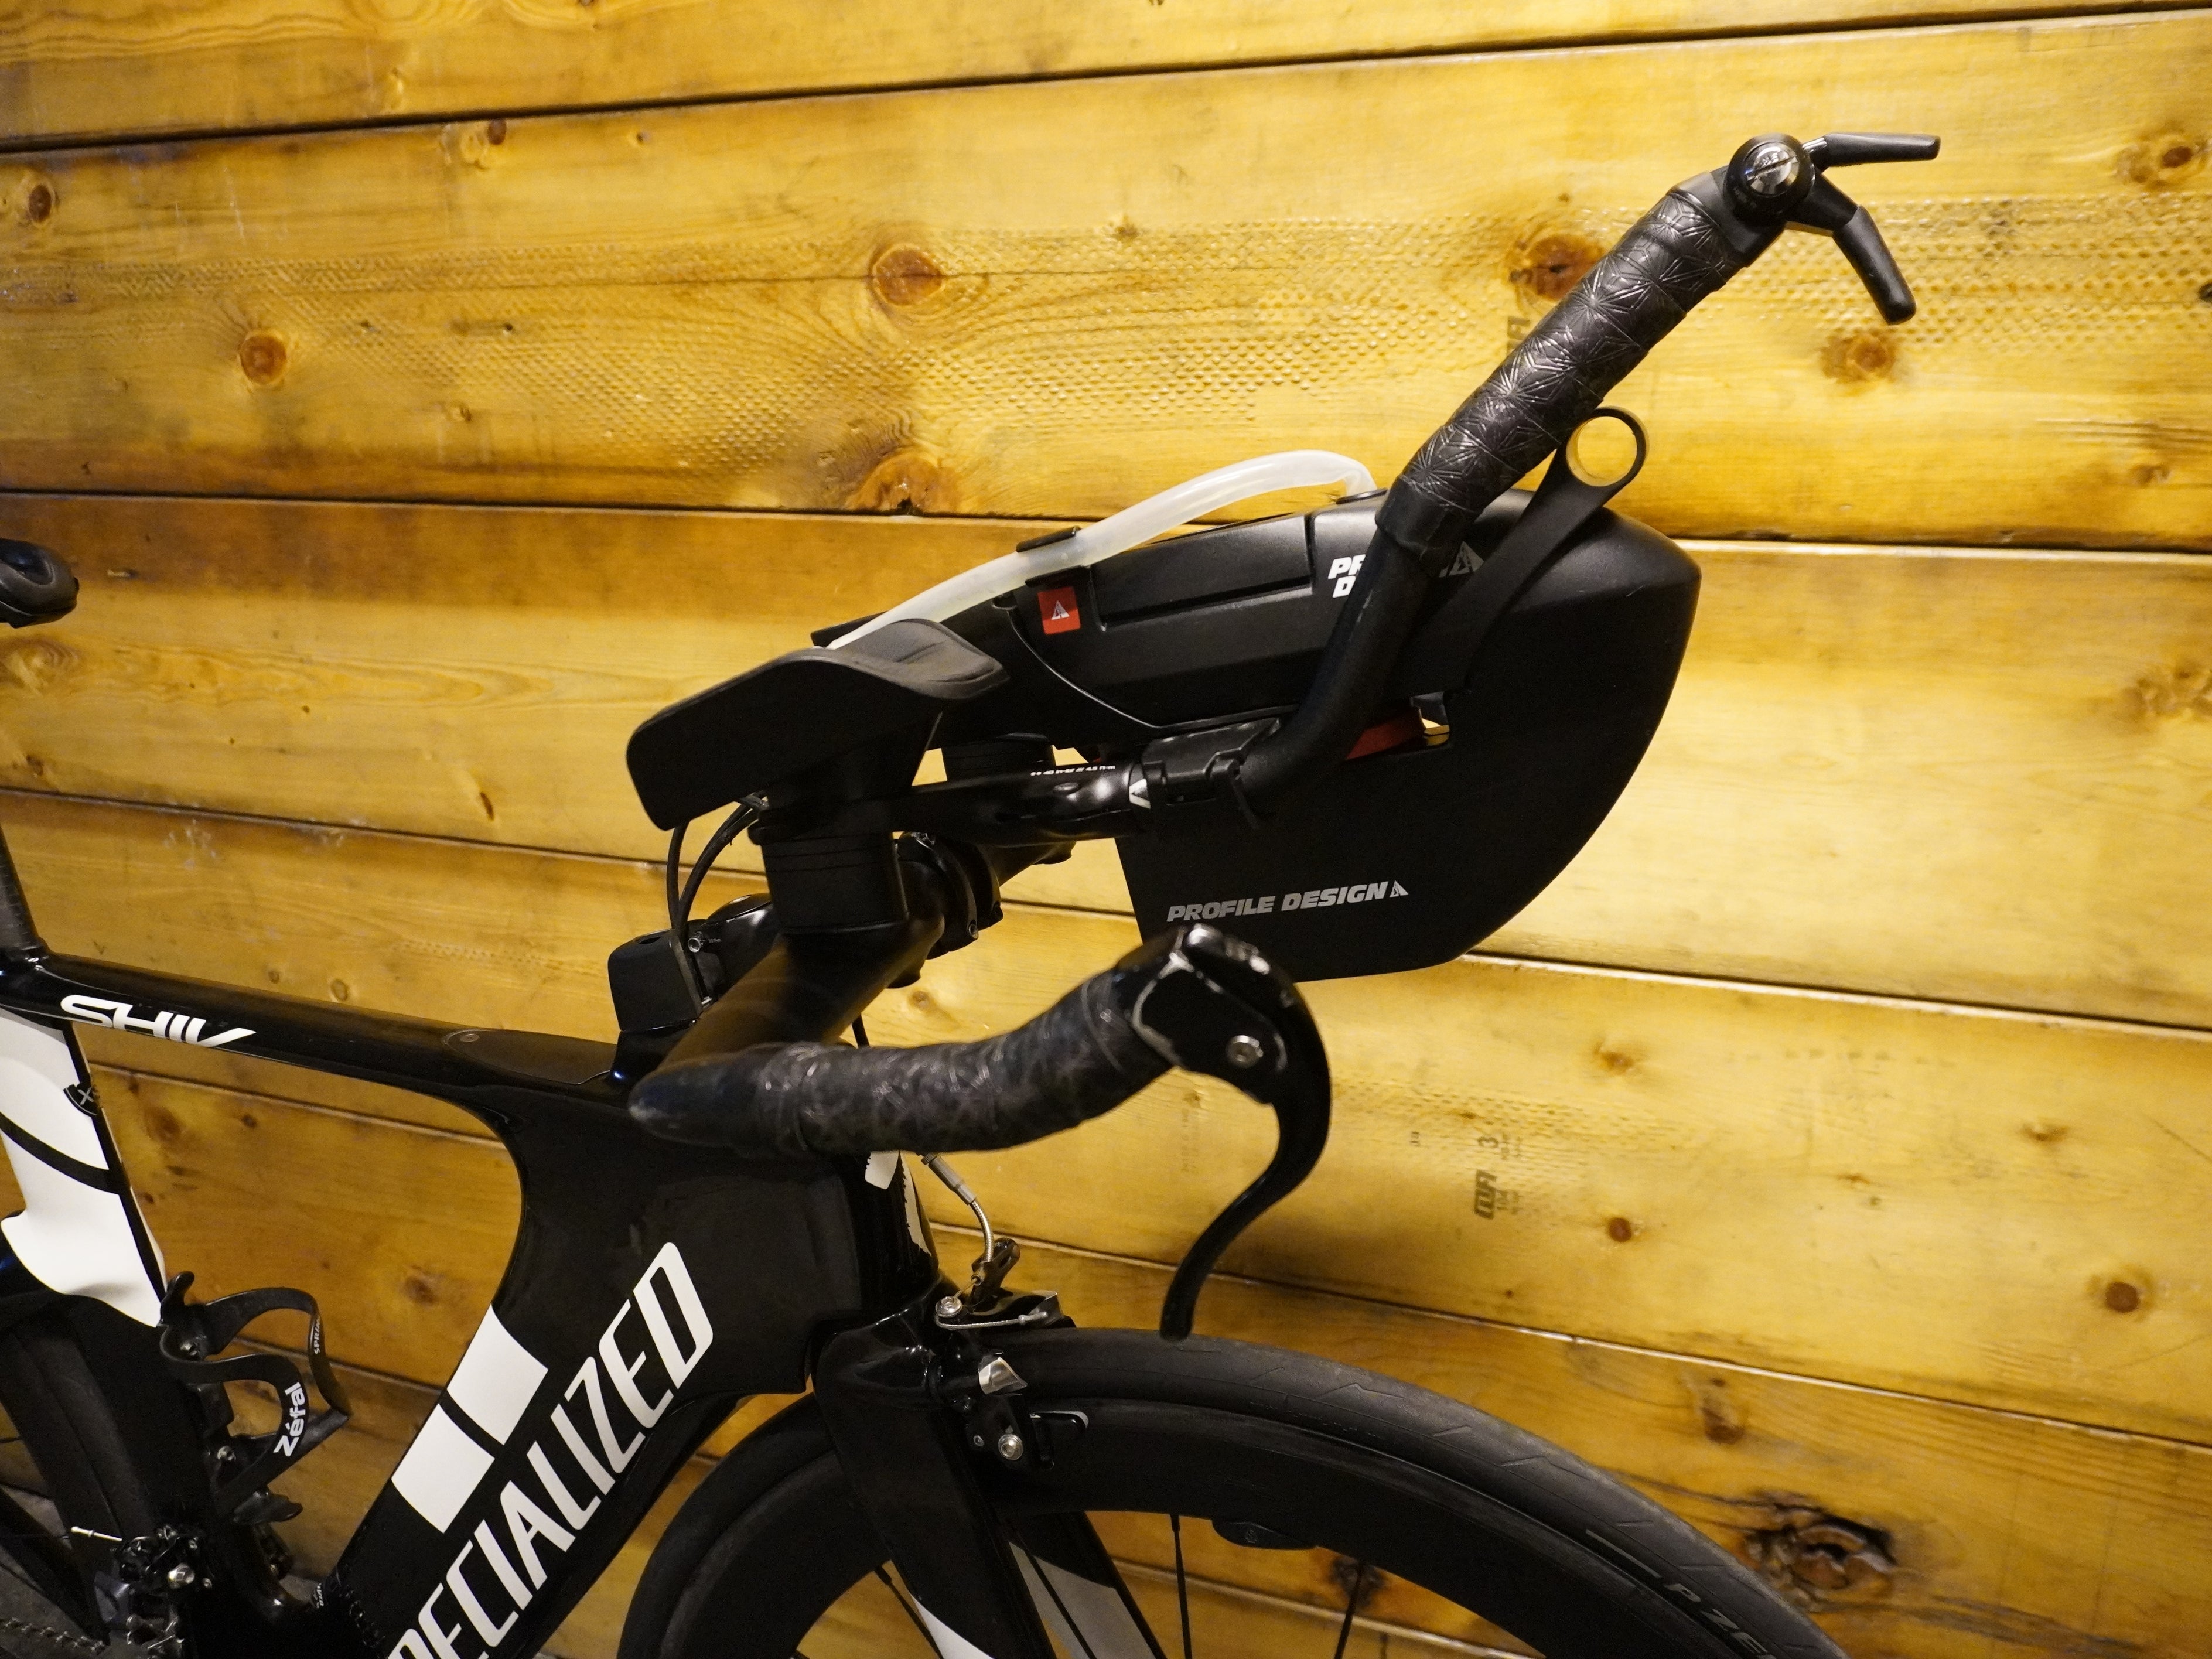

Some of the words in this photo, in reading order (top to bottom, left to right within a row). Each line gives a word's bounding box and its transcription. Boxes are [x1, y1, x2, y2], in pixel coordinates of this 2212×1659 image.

[1166, 895, 1276, 922] PROFILE
[1281, 880, 1389, 912] DESIGN
[60, 995, 257, 1047] SHIV
[273, 1382, 306, 1456] Zéfal
[1701, 1608, 1777, 1659] ZE
